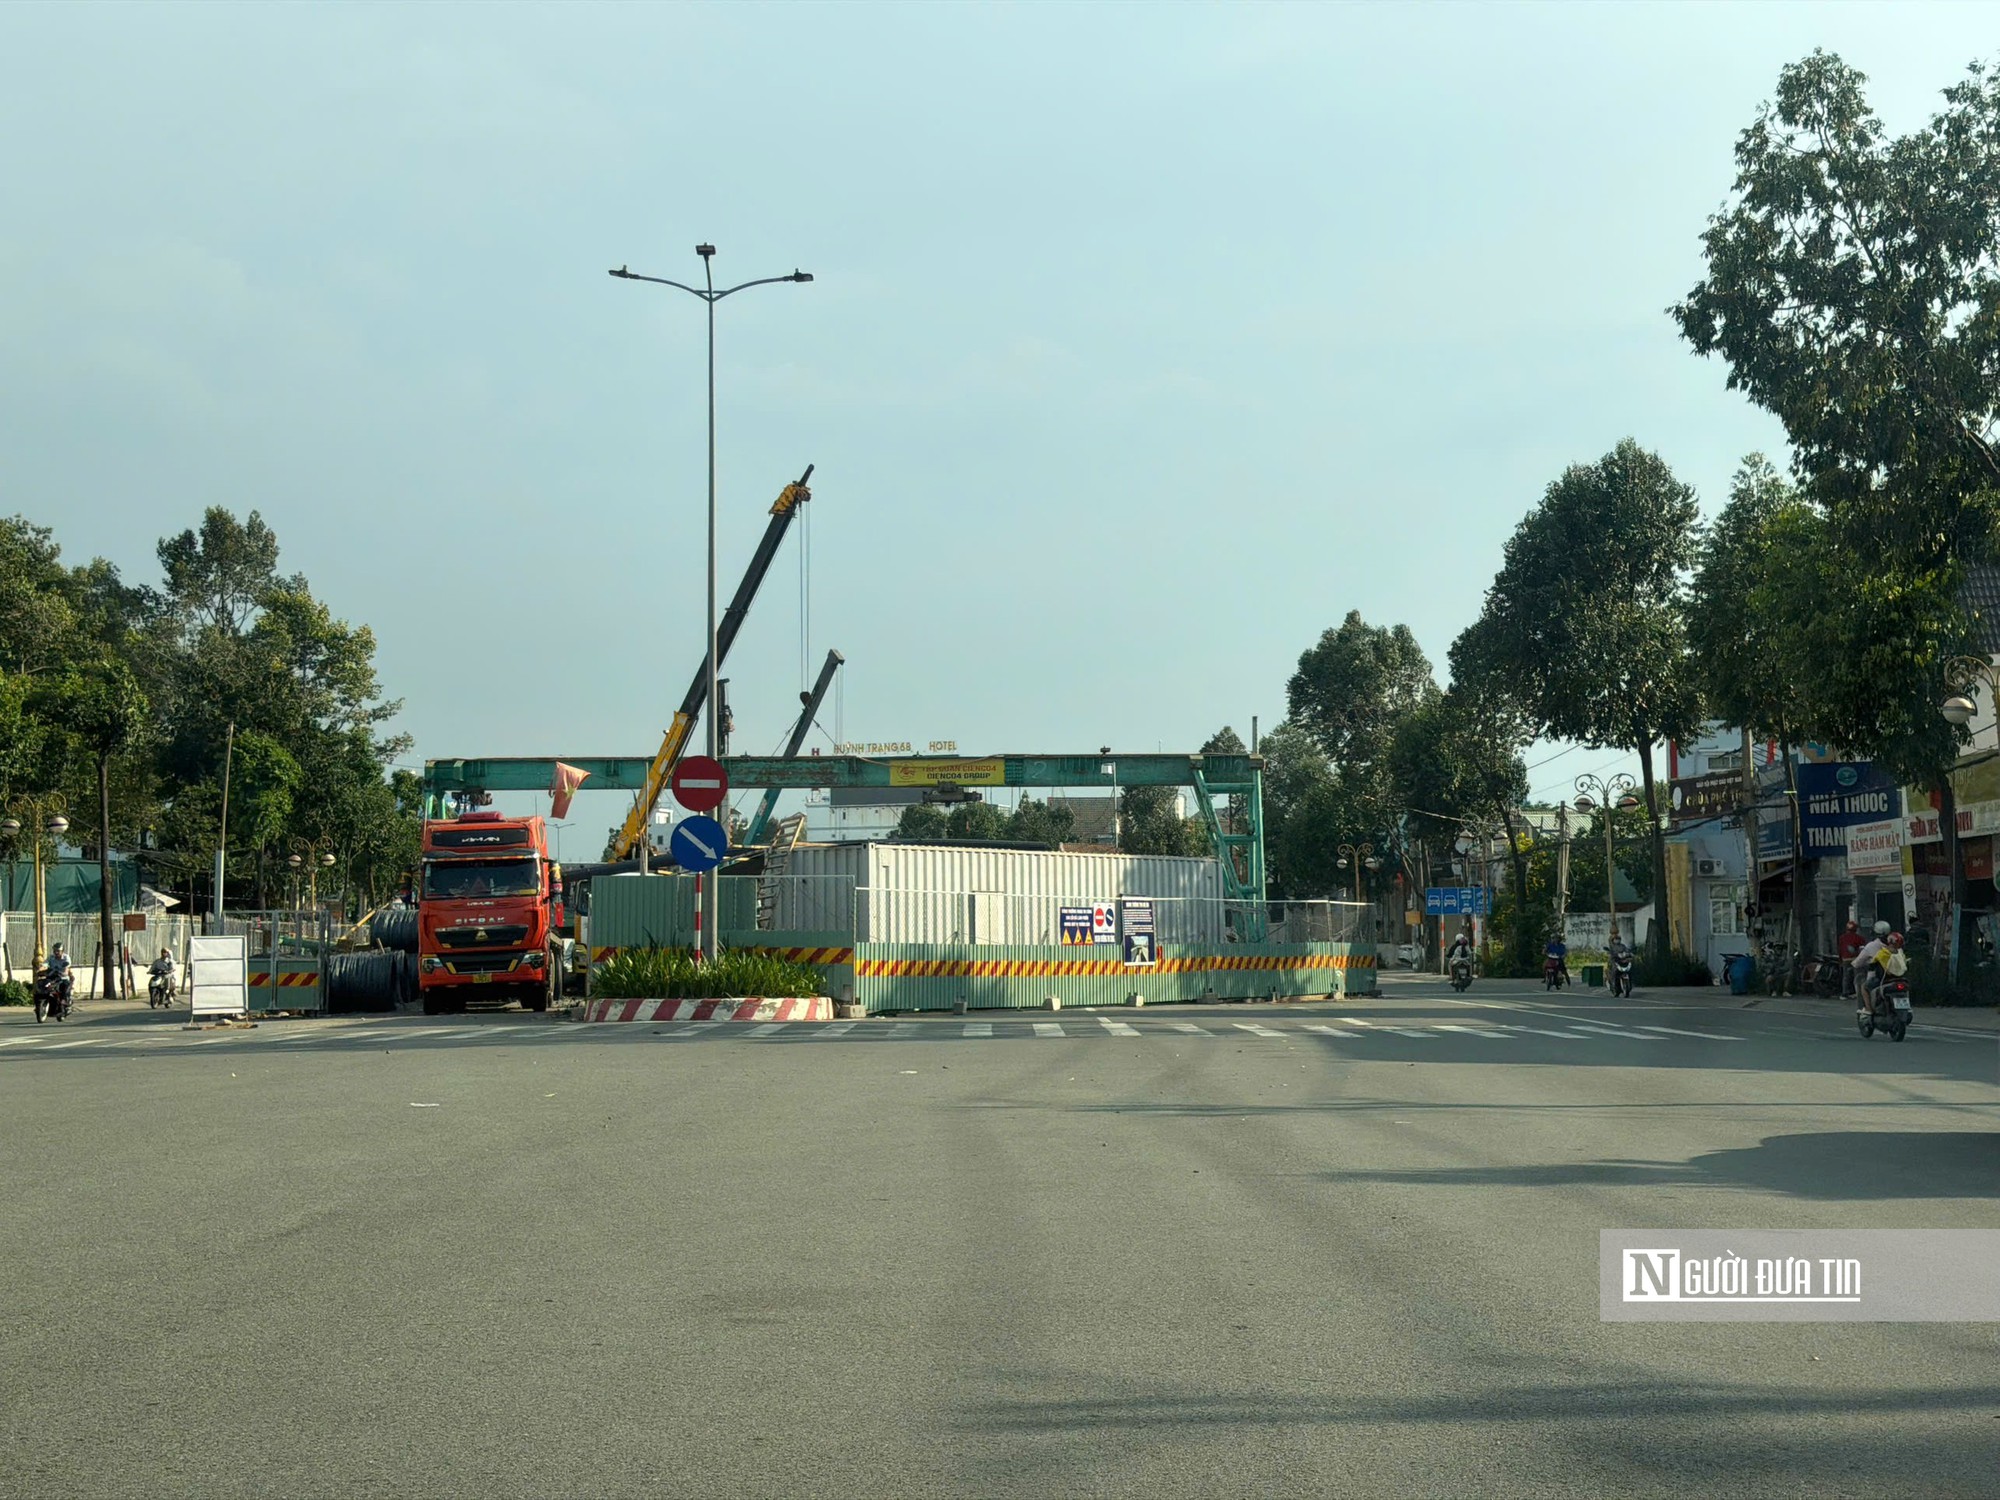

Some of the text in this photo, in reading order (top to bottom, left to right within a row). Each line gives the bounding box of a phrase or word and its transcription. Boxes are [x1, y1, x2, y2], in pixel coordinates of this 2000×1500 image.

[867, 742, 898, 753] TRANG
[899, 742, 912, 752] 68
[929, 740, 957, 751] HOTEL
[963, 772, 991, 780] GROUP
[1808, 789, 1840, 814] NHÀ
